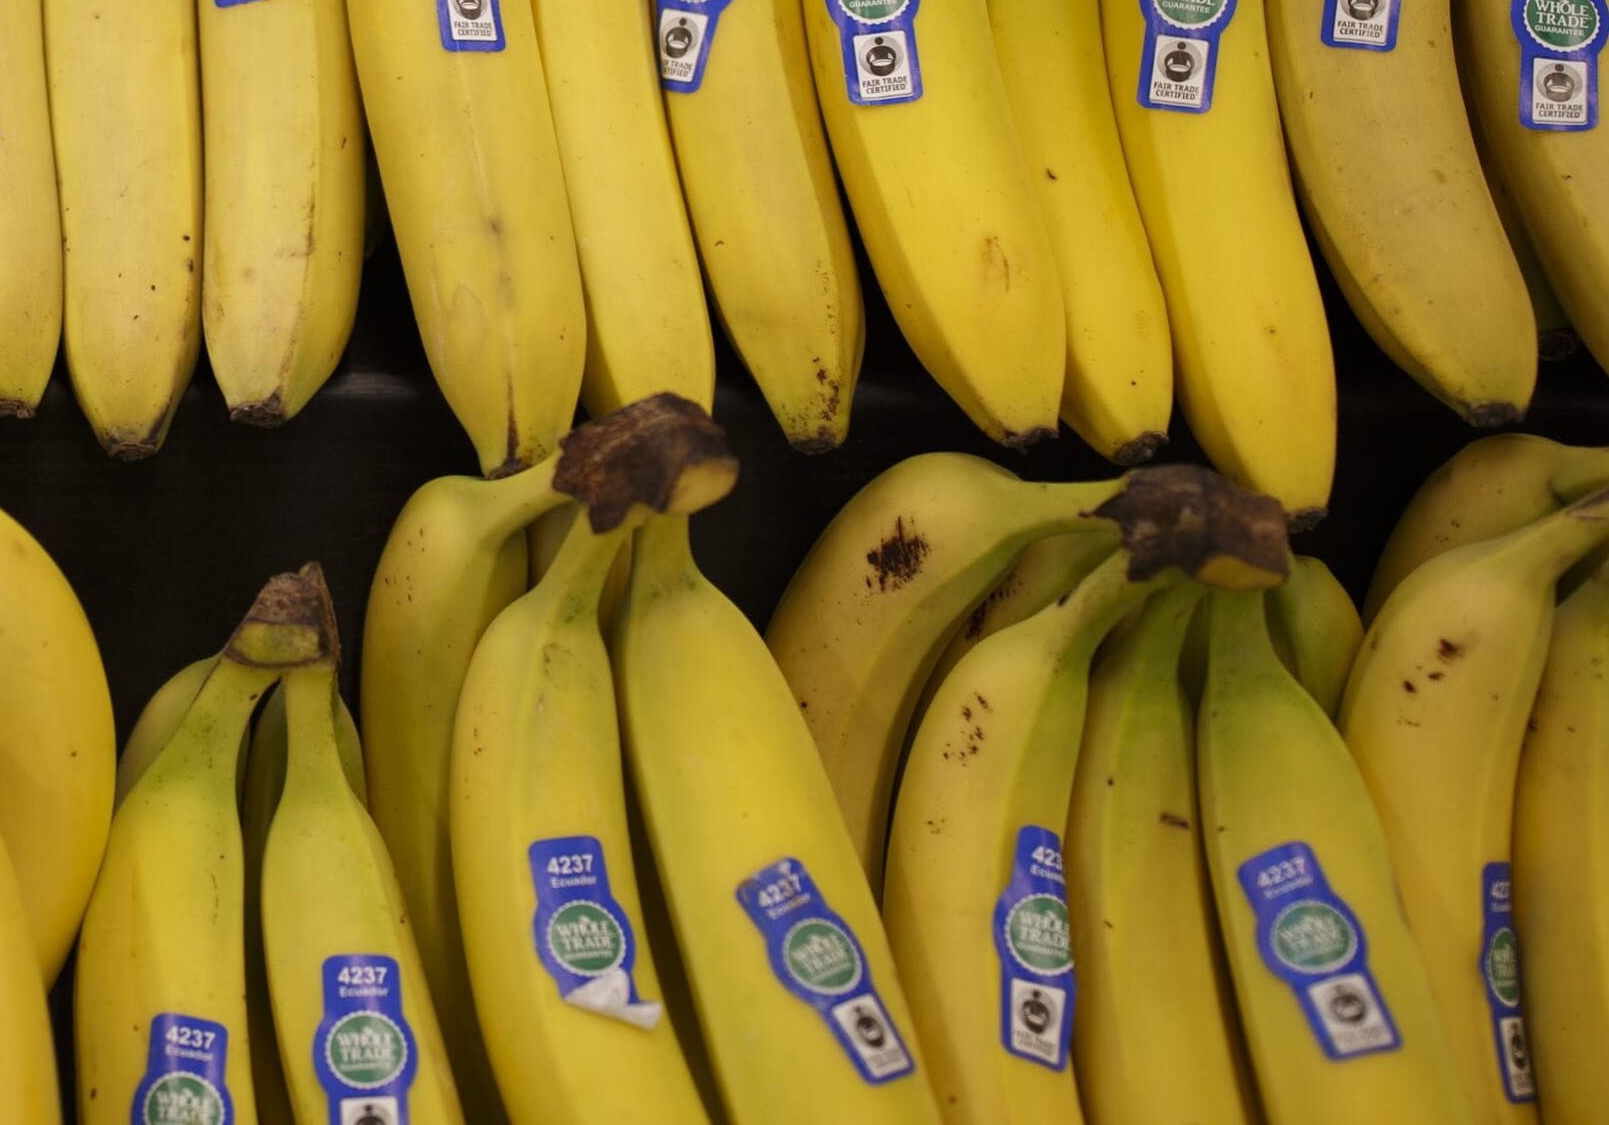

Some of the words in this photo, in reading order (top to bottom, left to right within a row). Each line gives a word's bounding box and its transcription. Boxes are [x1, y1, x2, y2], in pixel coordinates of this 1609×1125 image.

[1162, 1, 1210, 14] GUARANTEE
[1337, 20, 1357, 29] FAIR
[1359, 22, 1384, 32] TRADE
[1536, 12, 1589, 29] TRADE
[1339, 27, 1381, 38] CERTIFIED
[1534, 24, 1585, 36] GUARANTEE
[1153, 81, 1172, 90] FAIR
[1174, 84, 1200, 94] TRADE
[1155, 89, 1196, 101] CERTIFIED
[1535, 103, 1555, 111] FAIR
[1557, 103, 1583, 112] TRADE
[1538, 109, 1582, 119] CERTIFIED
[547, 854, 594, 875] 4237
[1257, 856, 1305, 887] 4237
[337, 967, 387, 985] 4237
[165, 1025, 216, 1050] 4237
